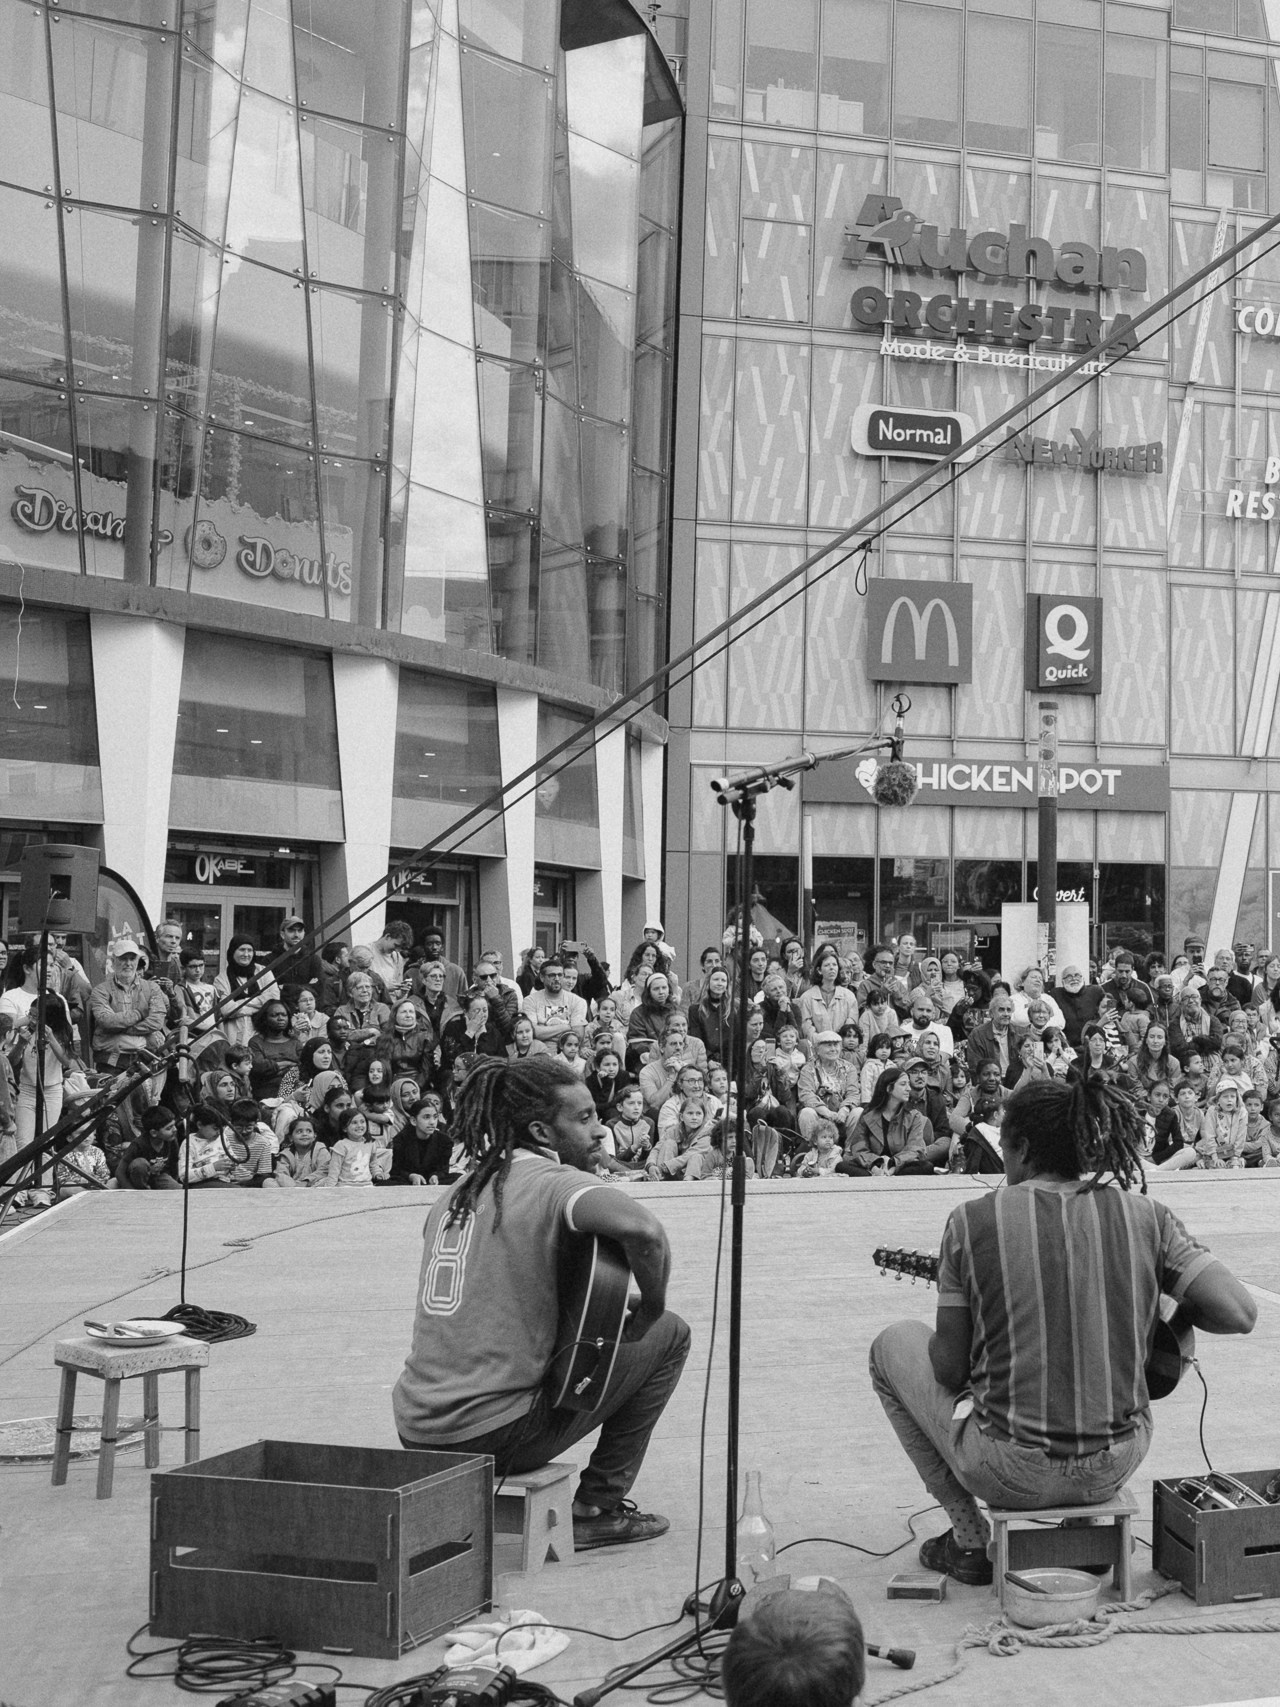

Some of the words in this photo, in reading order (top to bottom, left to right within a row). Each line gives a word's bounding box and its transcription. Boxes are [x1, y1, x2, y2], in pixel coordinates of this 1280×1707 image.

[842, 194, 1147, 292] Auchan
[850, 286, 1140, 351] ORCHESTRA
[880, 338, 945, 361] Mode
[953, 344, 970, 362] &
[878, 418, 952, 445] Normal
[1045, 604, 1091, 660] Q
[1045, 664, 1088, 682] Quick
[907, 762, 1033, 793] HICKEN
[1057, 767, 1122, 796] POT
[1033, 886, 1085, 902] vert
[112, 921, 133, 938] LA
[421, 1210, 477, 1316] 8
